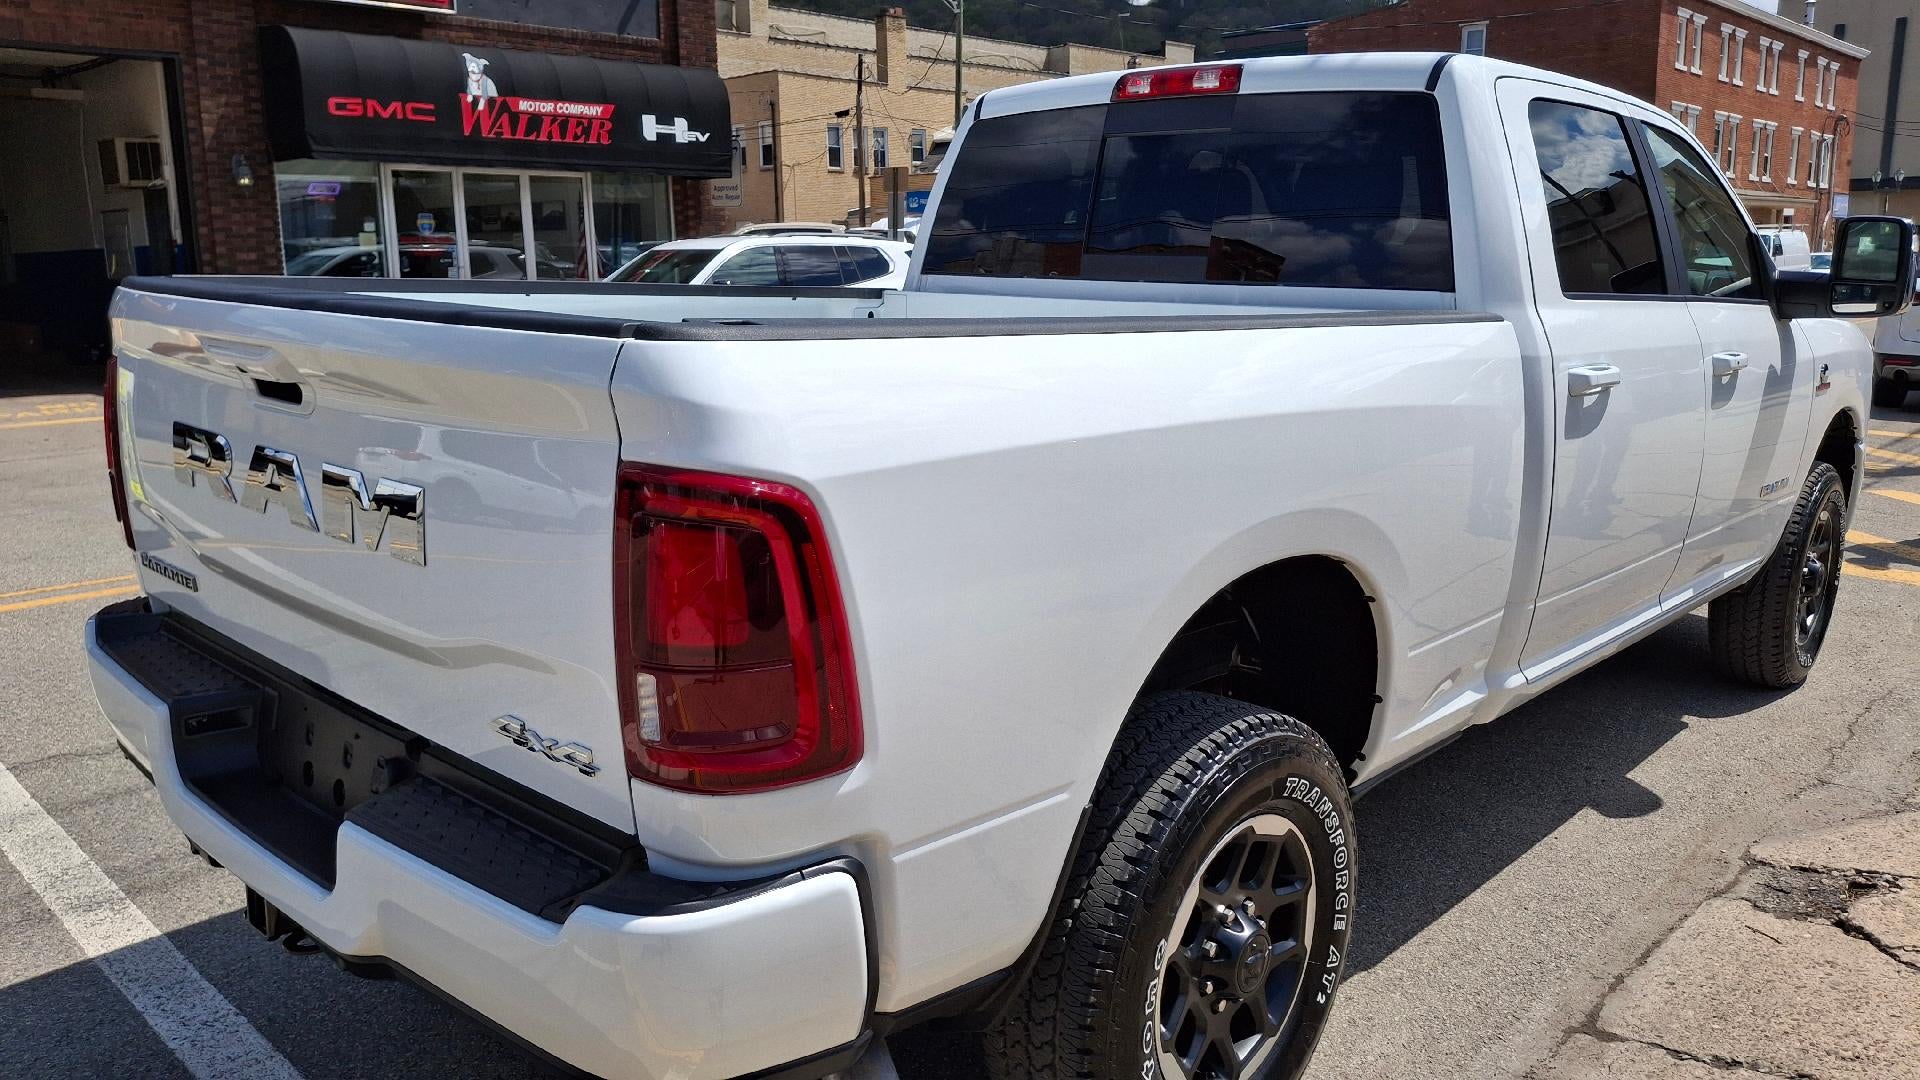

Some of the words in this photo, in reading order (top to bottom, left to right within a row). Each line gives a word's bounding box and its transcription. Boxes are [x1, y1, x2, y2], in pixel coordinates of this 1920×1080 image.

[328, 97, 436, 122] GMC
[457, 93, 613, 145] WALKER
[519, 100, 554, 113] MOTOR
[557, 102, 604, 116] COMPANY
[173, 420, 427, 567] RAM
[141, 552, 194, 590] LARAMIE
[1282, 777, 1349, 930] TRANSFORCE
